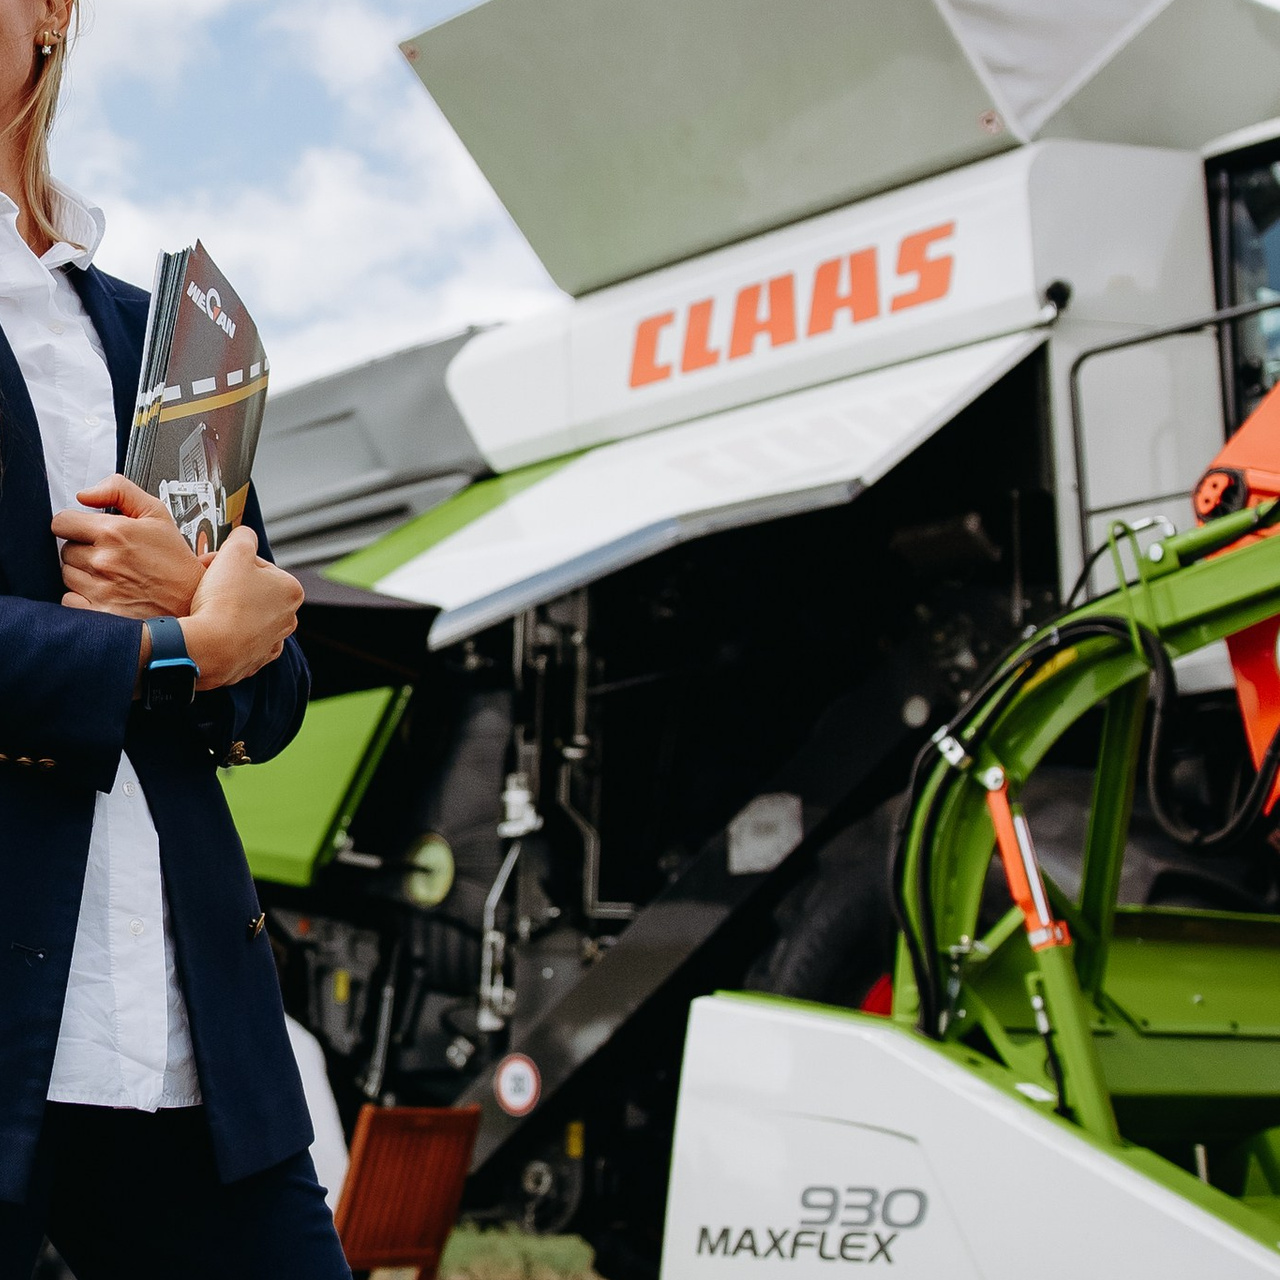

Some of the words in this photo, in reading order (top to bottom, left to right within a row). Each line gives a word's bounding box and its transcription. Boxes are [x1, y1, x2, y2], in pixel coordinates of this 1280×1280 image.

[186, 280, 237, 339] WECAN
[628, 219, 956, 390] CLAAS
[799, 1185, 929, 1230] 930
[696, 1225, 899, 1265] MAXFLEX
